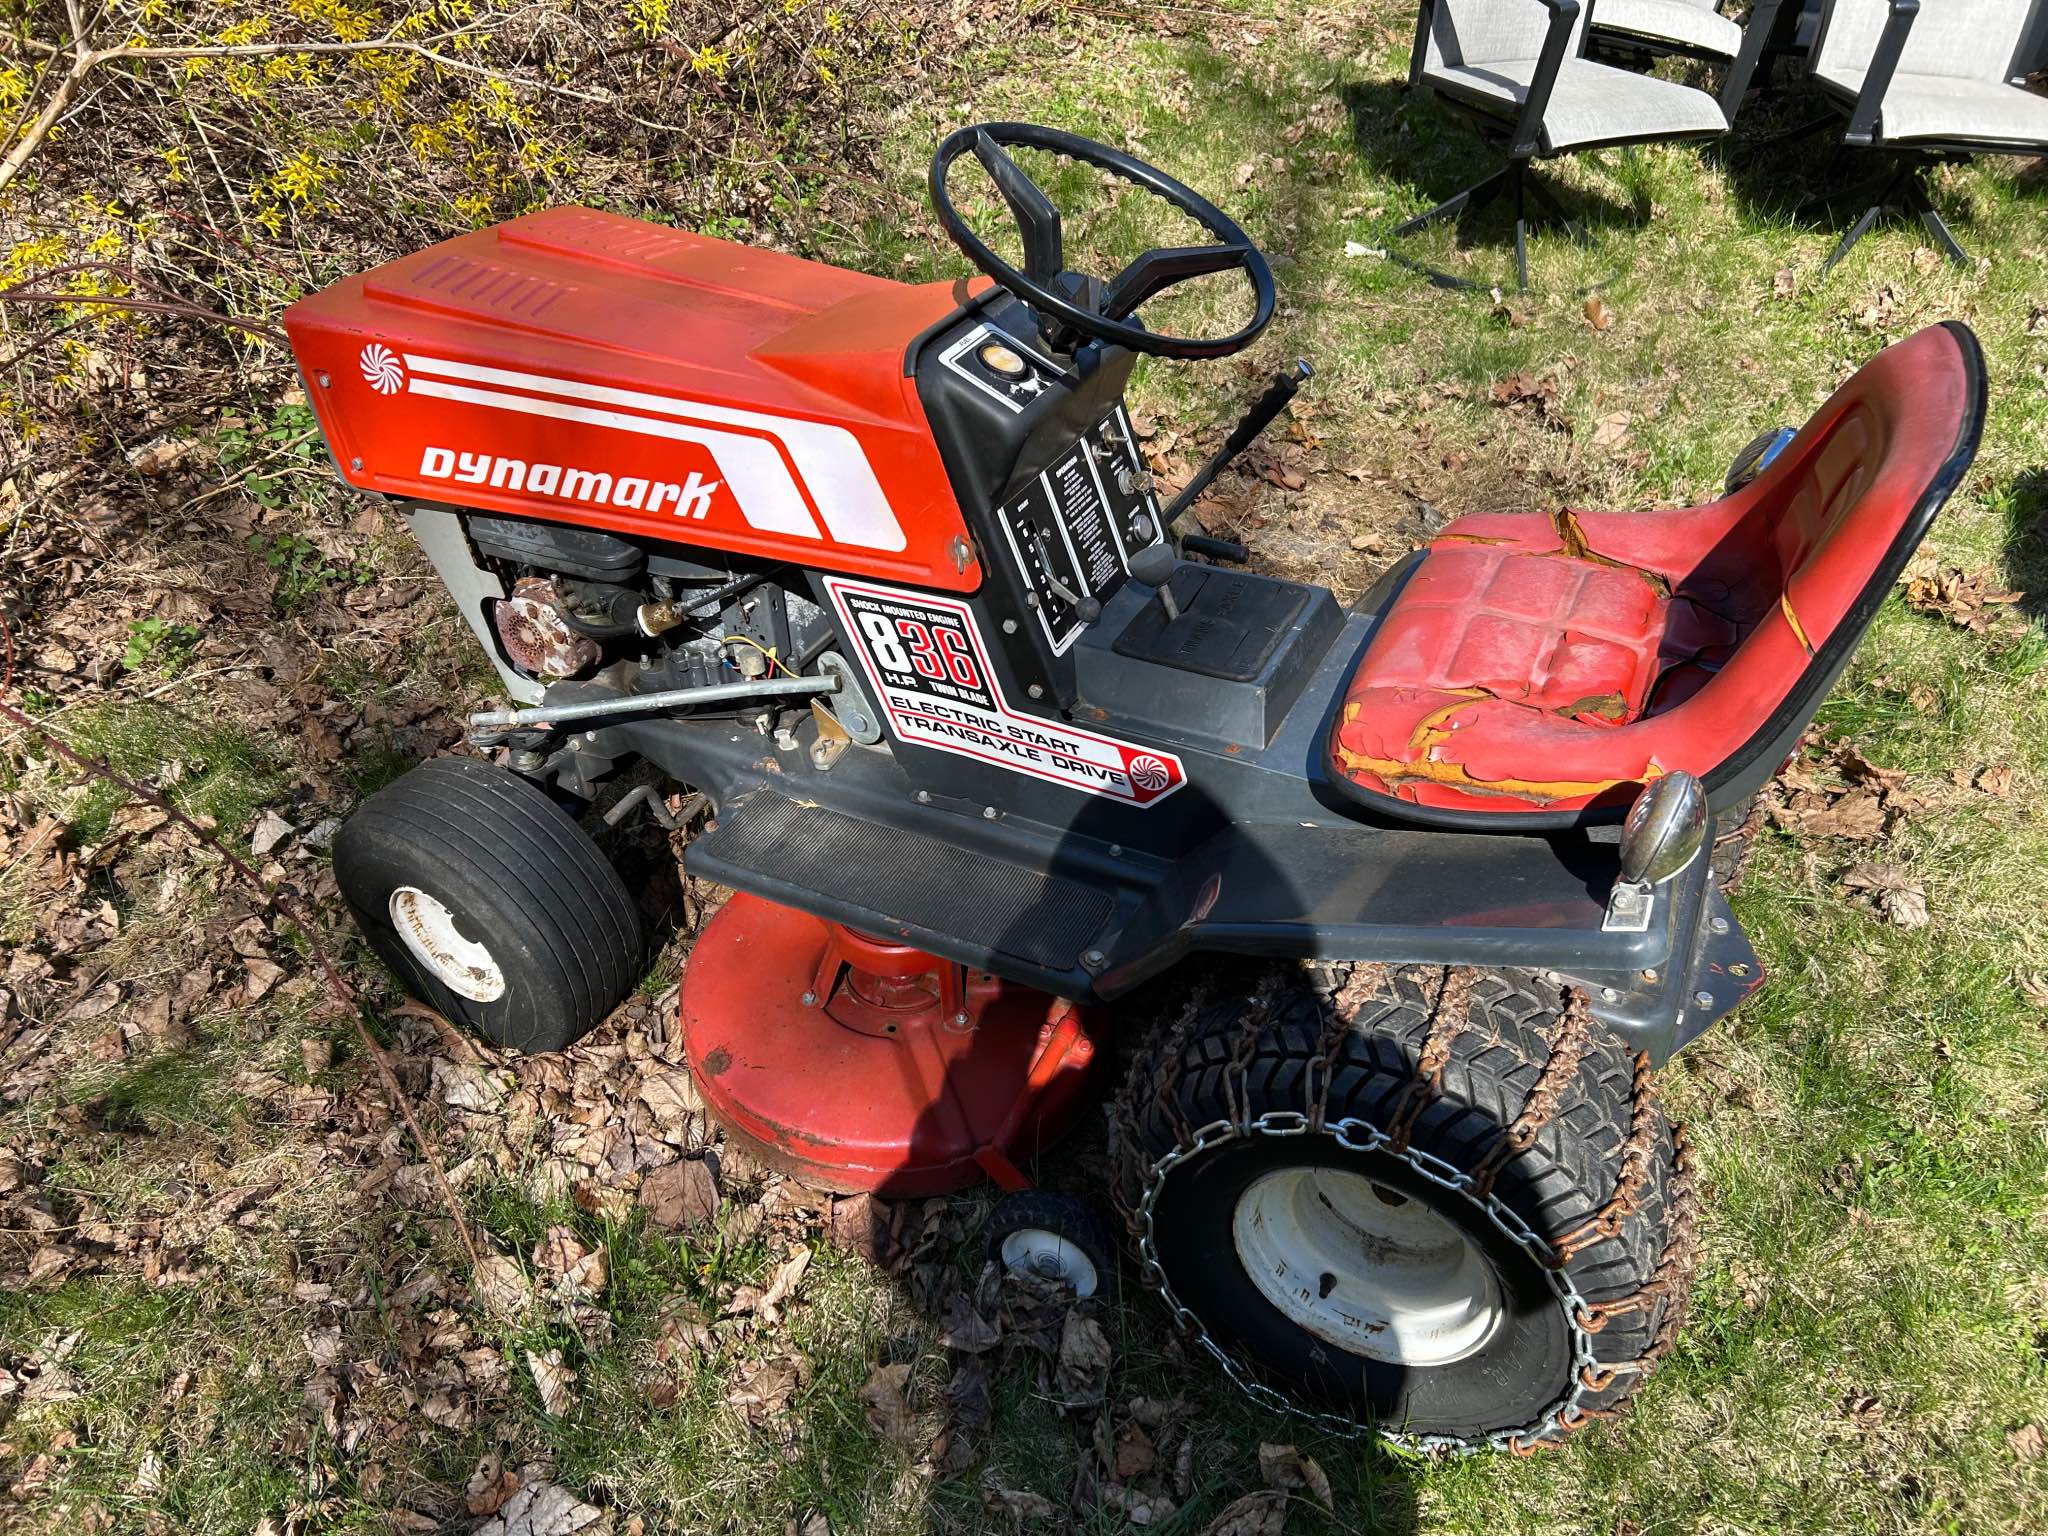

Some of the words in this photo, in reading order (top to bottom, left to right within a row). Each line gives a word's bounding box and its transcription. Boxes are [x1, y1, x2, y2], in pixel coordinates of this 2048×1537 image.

[419, 446, 721, 520] Dynamark
[1022, 527, 1029, 538] 6
[1028, 543, 1035, 554] 5
[1034, 559, 1041, 568] 4
[1040, 574, 1046, 584] 3
[1046, 590, 1053, 600] 2
[850, 598, 882, 613] SHOCK
[881, 604, 927, 621] MOUNTED
[927, 612, 961, 628] ENGINE
[1052, 604, 1058, 613] 1
[884, 671, 919, 688] H.P.
[928, 681, 958, 697] TWIN
[958, 688, 990, 707] BLADE
[890, 696, 1002, 733] ELECTRIC
[1006, 725, 1080, 756] START
[898, 714, 1043, 763] TRANSAXLE
[1051, 758, 1126, 786] DRIVE
